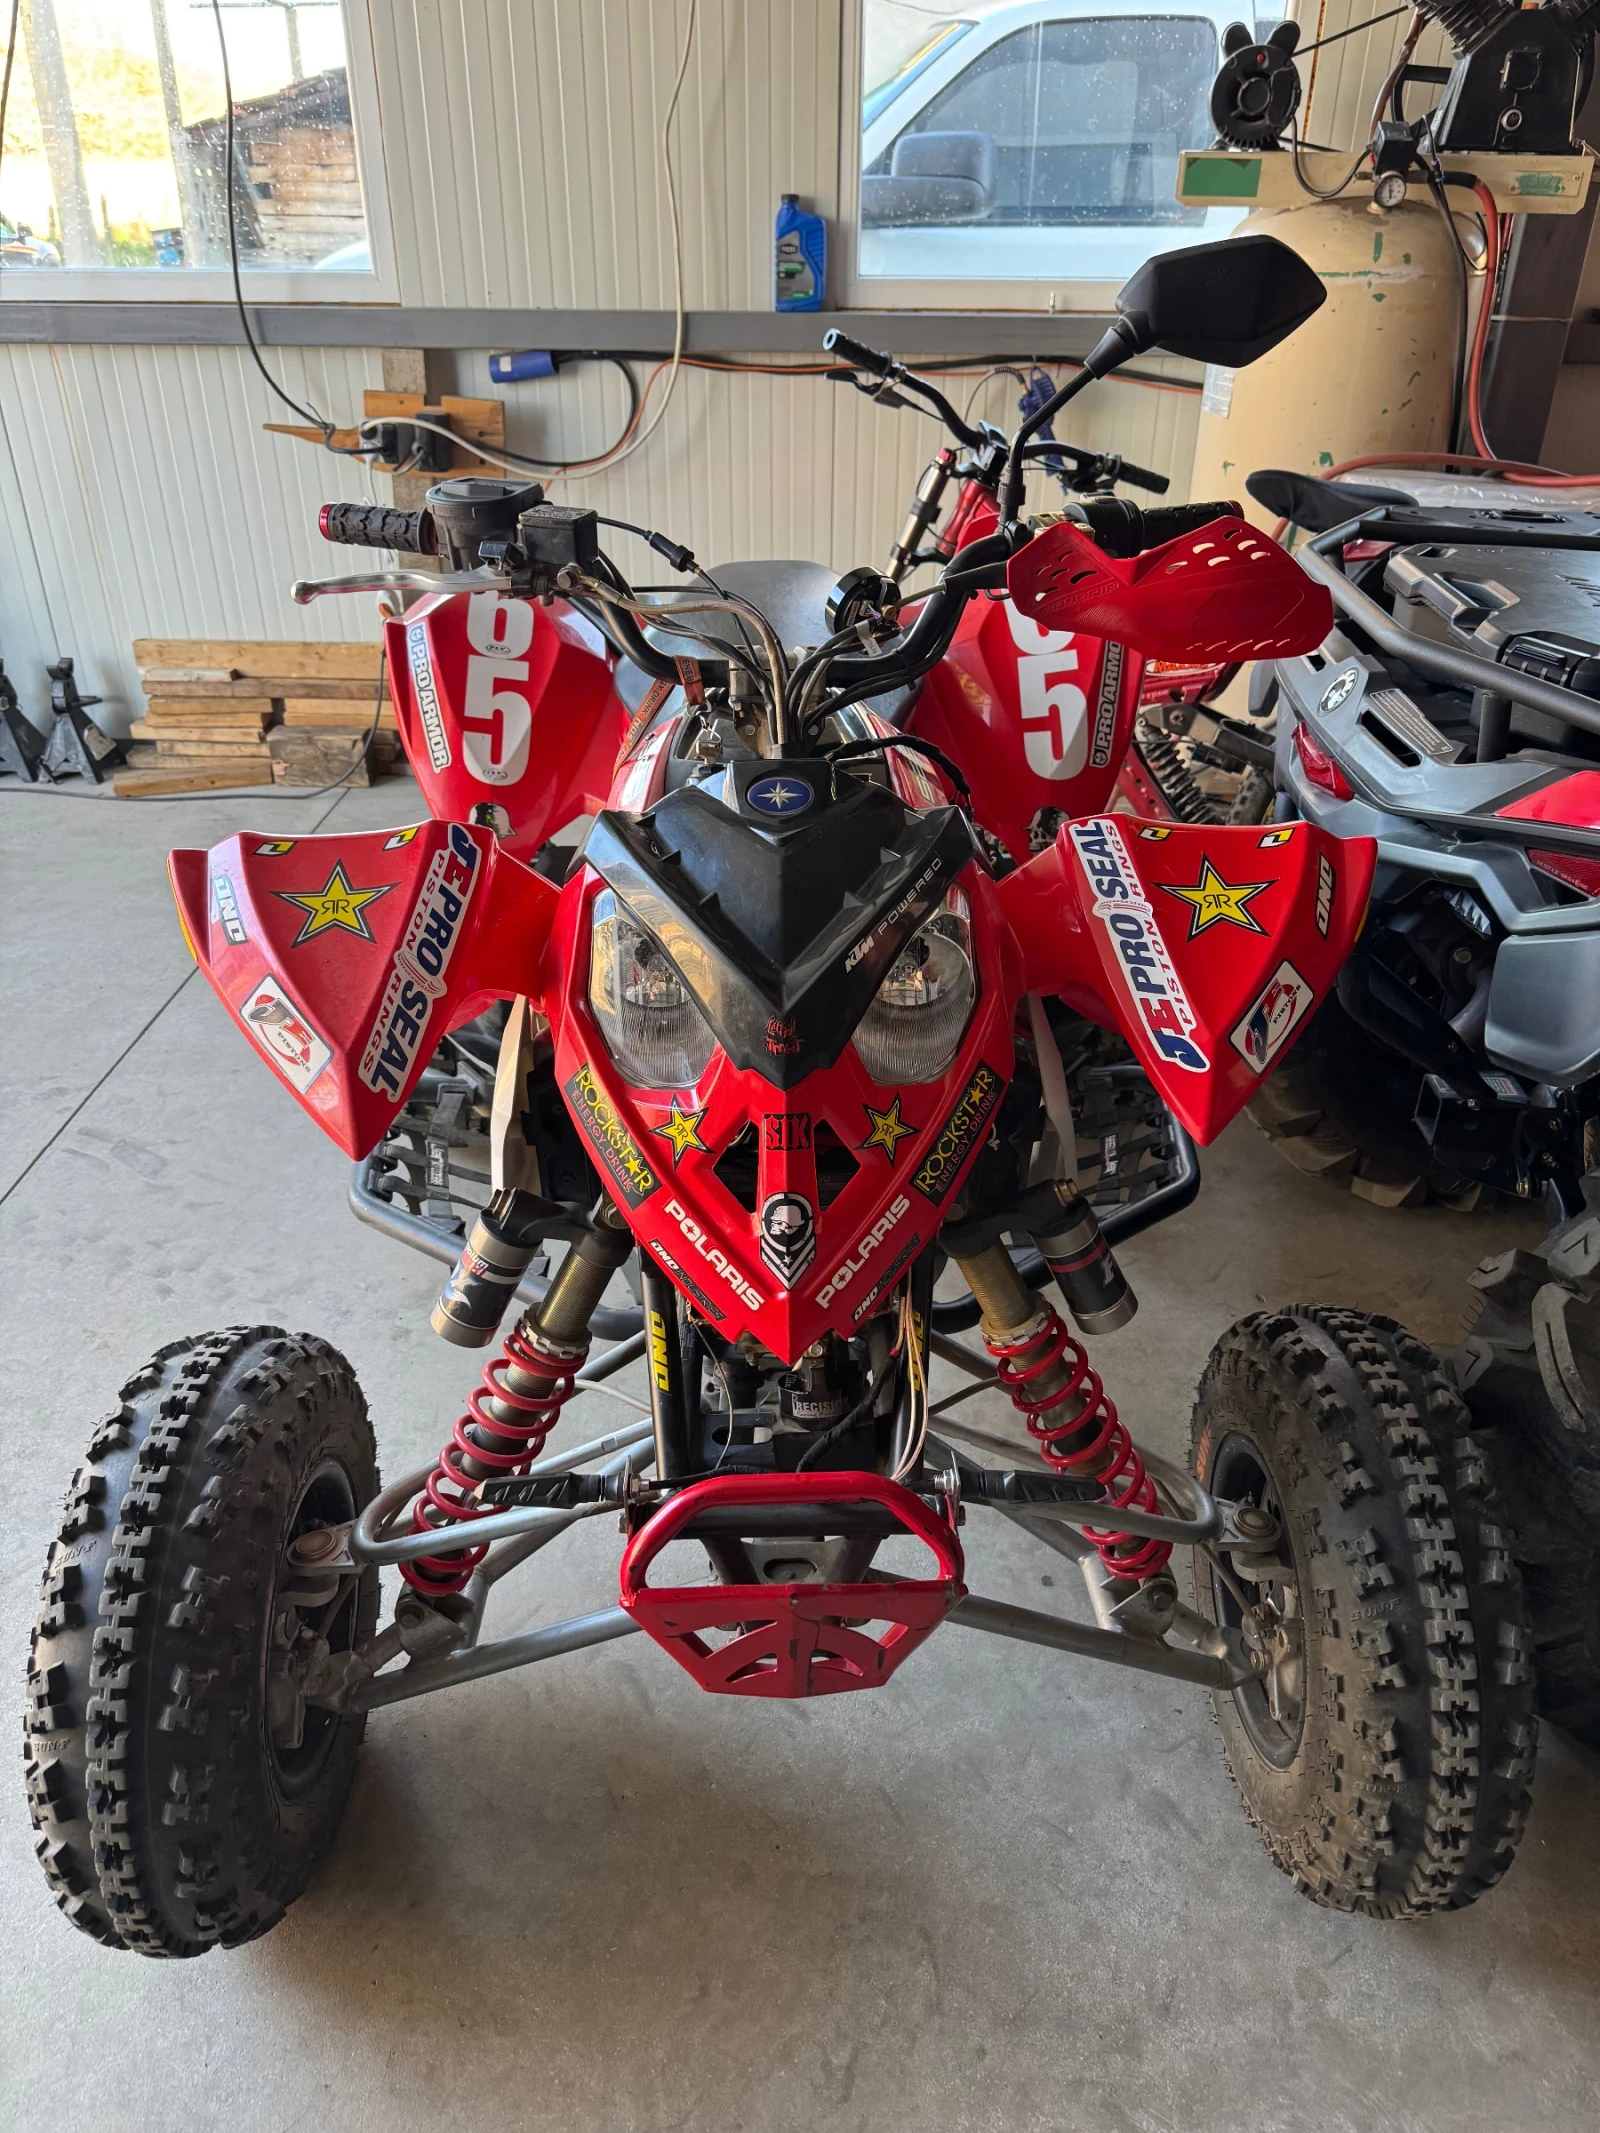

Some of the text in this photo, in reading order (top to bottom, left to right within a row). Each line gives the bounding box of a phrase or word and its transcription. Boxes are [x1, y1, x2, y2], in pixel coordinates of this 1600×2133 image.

[418, 688, 450, 769] ARMOR
[462, 654, 533, 786] 5
[1017, 648, 1090, 781] 5
[1095, 641, 1122, 749] PRO ARMO
[406, 853, 445, 951] PISTON
[1075, 821, 1130, 900] SEAL
[1105, 825, 1143, 897] RINGS
[416, 884, 463, 977] PRO
[844, 856, 942, 973] KTM POWERED
[1110, 914, 1168, 995] PRO
[364, 972, 403, 1073] RINGS
[1144, 920, 1194, 1025] PISTON
[1272, 984, 1301, 1026] PISTONS
[277, 1031, 311, 1073] PISTONS
[370, 980, 428, 1093] SEAL
[572, 1089, 634, 1192] ENERGY DRINK
[765, 1114, 810, 1151] SIK
[936, 1091, 997, 1191] ENERGY DRINK
[663, 1198, 765, 1311] POLARIS
[815, 1193, 911, 1310] POLARIS
